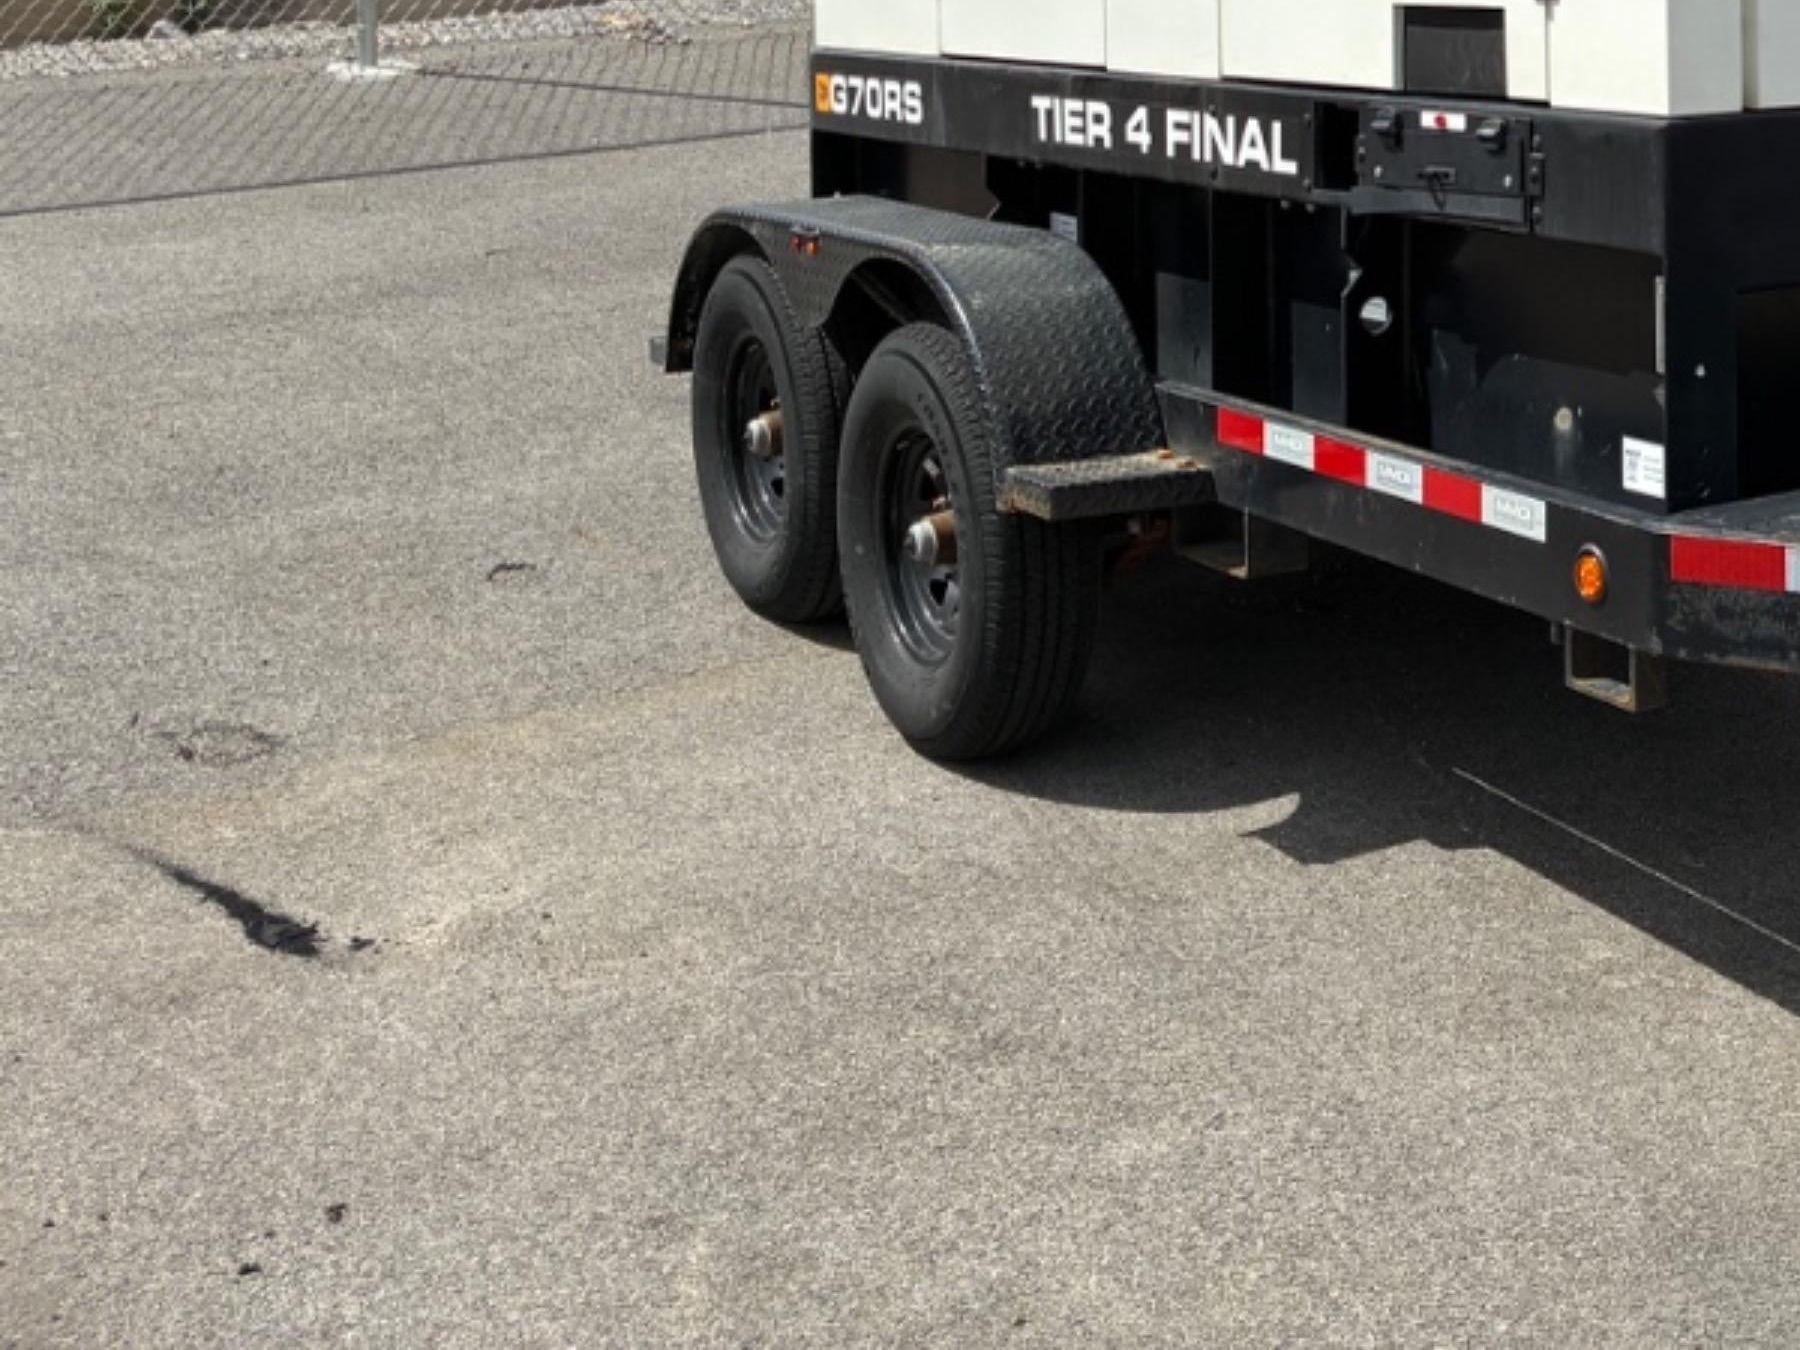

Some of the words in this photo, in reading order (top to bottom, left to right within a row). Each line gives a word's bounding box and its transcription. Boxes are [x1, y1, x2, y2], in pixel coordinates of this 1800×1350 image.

[830, 74, 922, 124] G70RS
[1031, 95, 1111, 149] TIER
[1125, 105, 1151, 152] 4
[1166, 107, 1298, 175] FINAL
